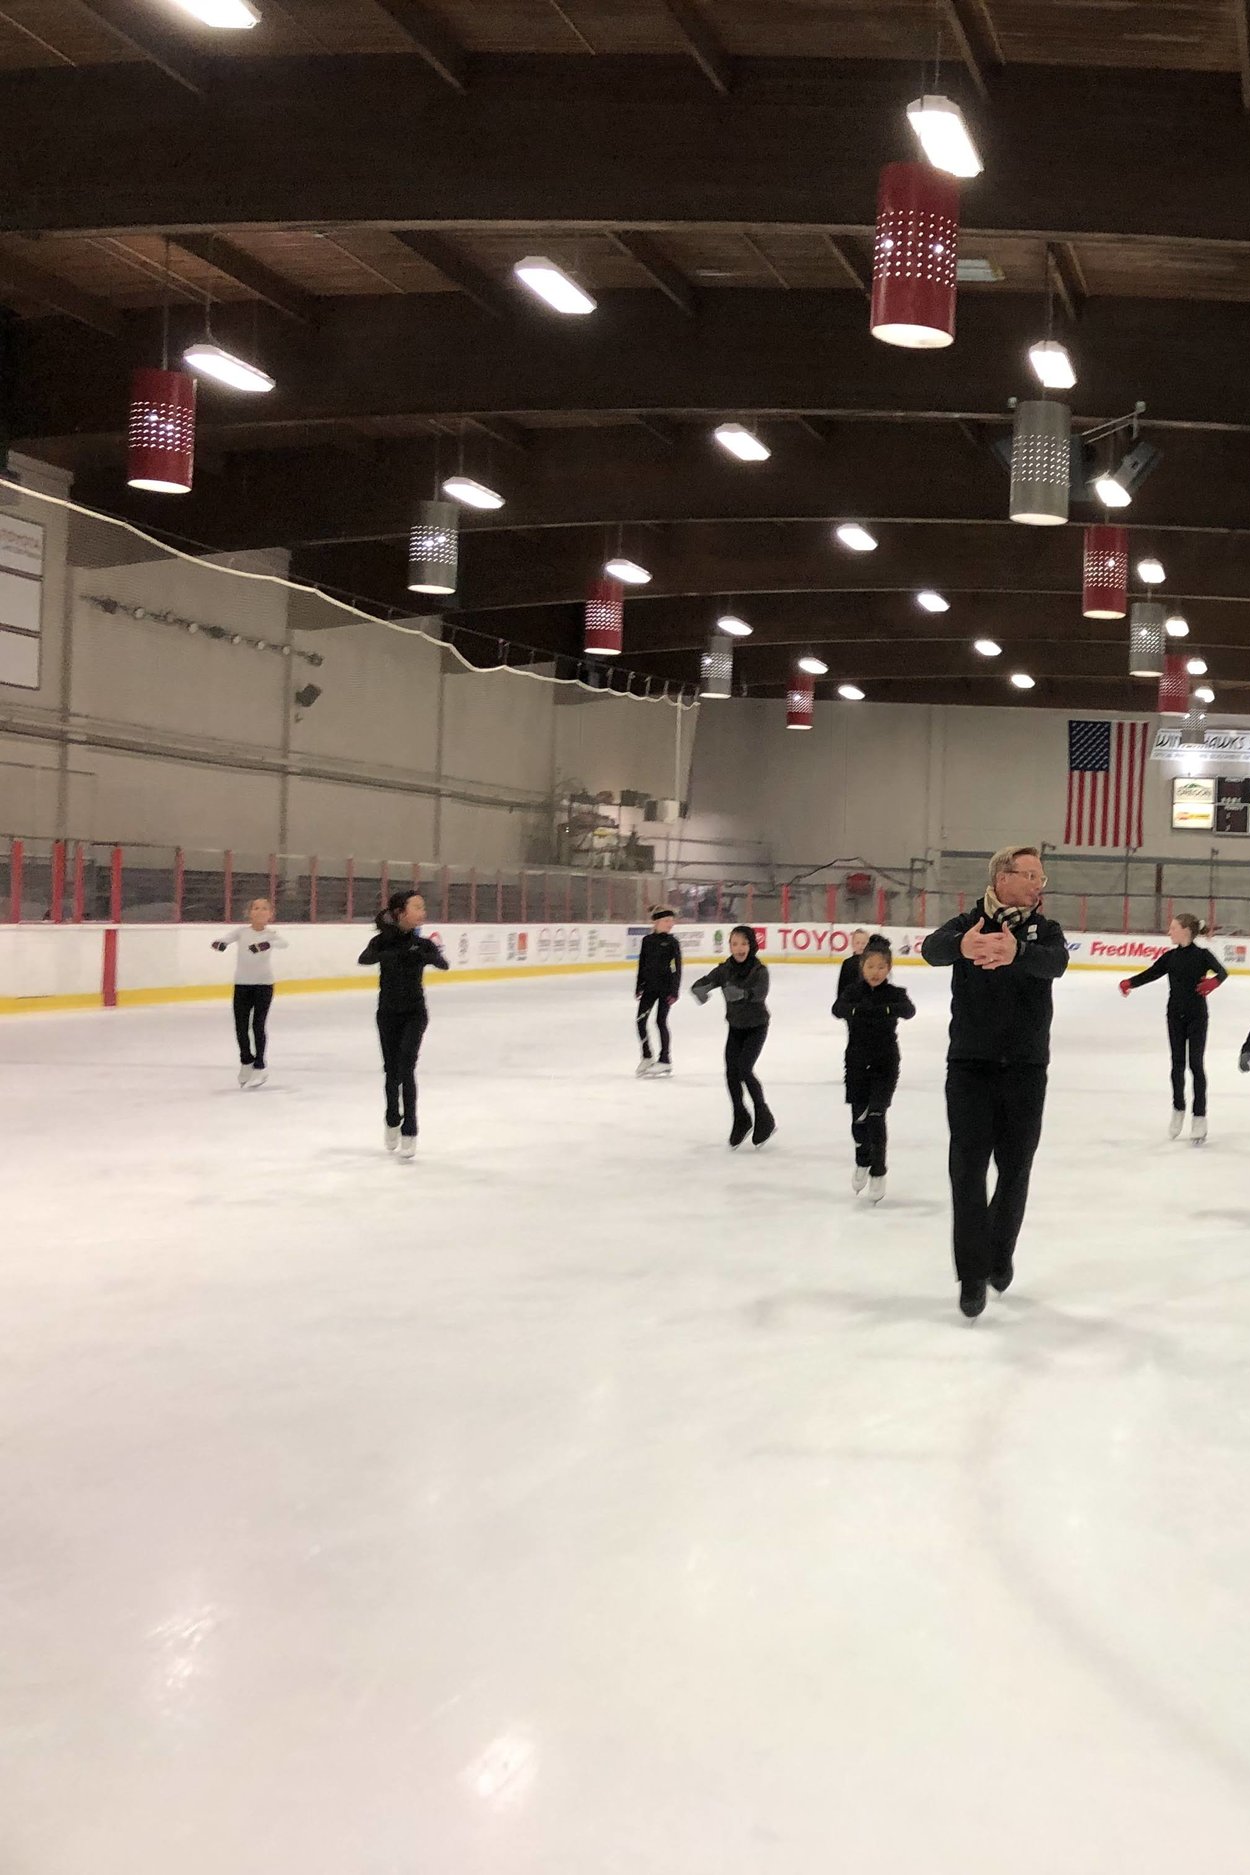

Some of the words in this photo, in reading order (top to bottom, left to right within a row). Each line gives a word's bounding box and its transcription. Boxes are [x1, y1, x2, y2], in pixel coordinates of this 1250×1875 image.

[1156, 734, 1246, 750] WINAWKS
[778, 928, 852, 952] TOYO
[1090, 941, 1128, 956] Fred
[1128, 943, 1168, 960] Mey
